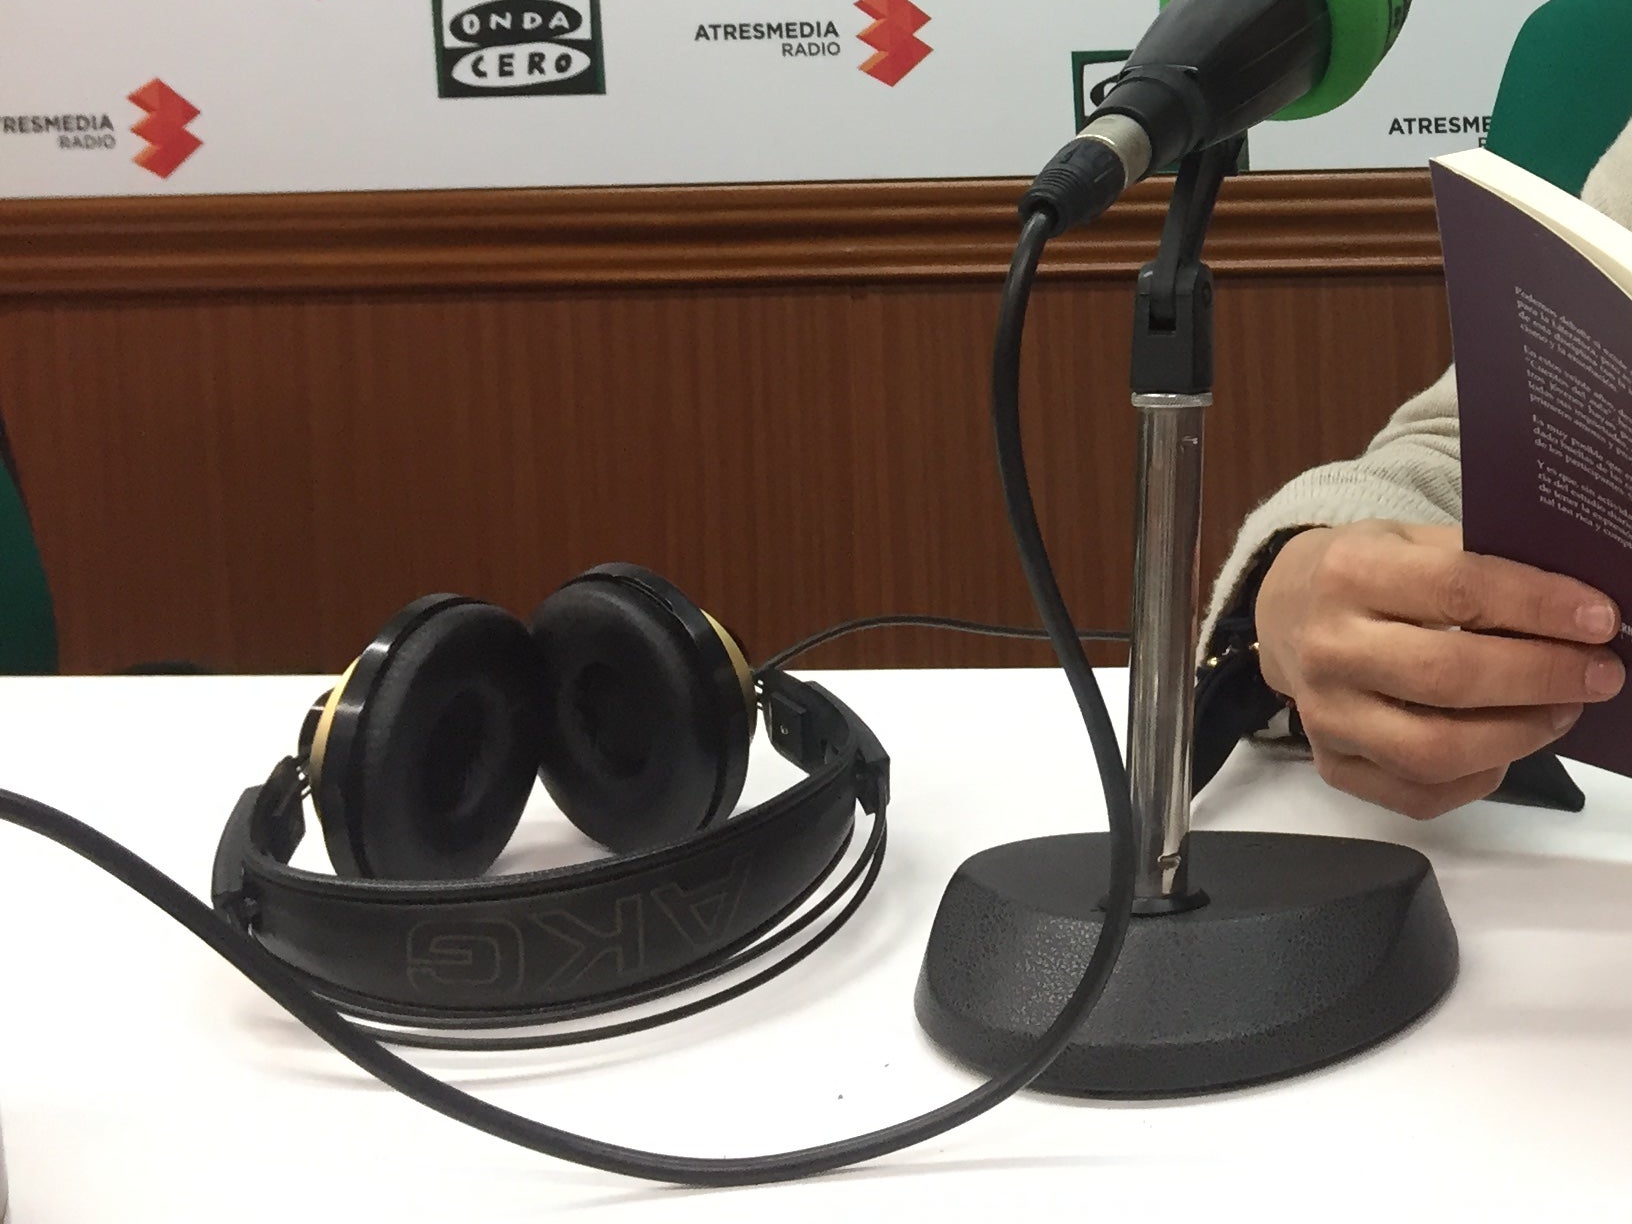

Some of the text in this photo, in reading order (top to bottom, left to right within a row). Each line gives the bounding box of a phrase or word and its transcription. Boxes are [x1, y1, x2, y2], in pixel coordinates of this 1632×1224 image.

[463, 12, 569, 34] ONDA
[694, 21, 840, 41] ATRESMEDIA
[782, 42, 840, 57] RADIO
[471, 52, 572, 78] CERO
[3, 114, 114, 134] RESMEDIA
[1389, 116, 1491, 135] ATRESME
[58, 134, 116, 149] RADIO
